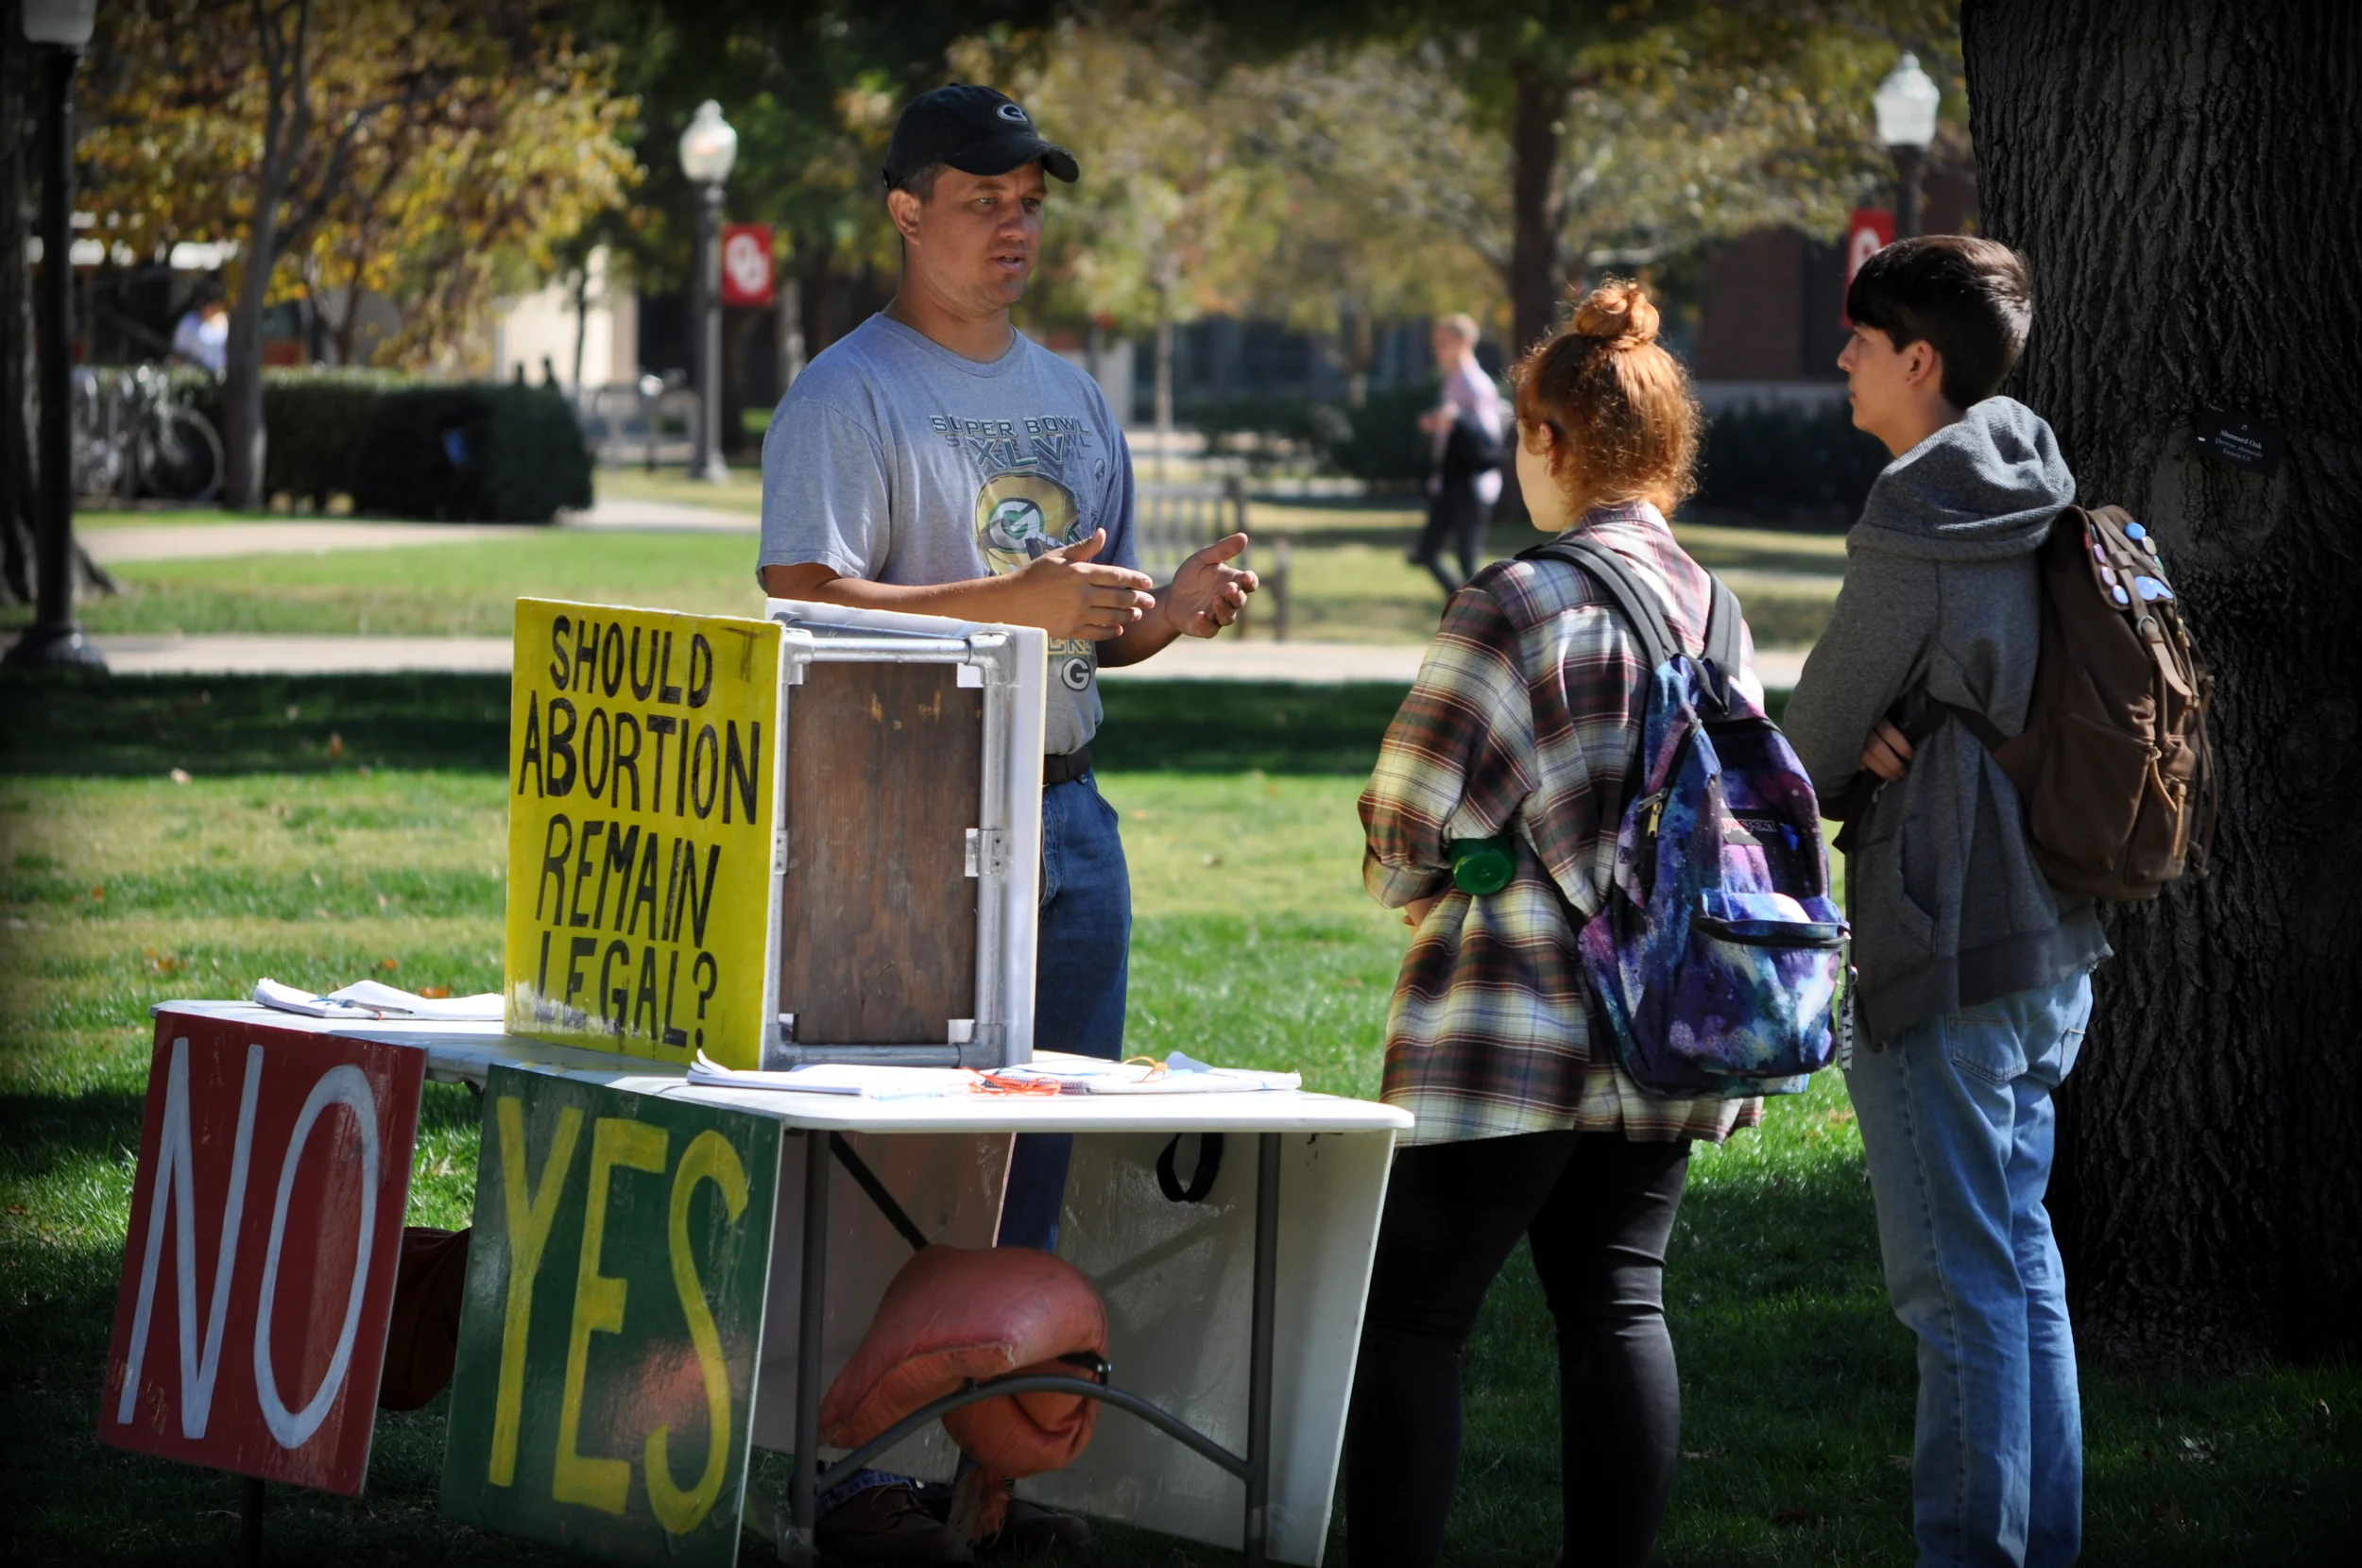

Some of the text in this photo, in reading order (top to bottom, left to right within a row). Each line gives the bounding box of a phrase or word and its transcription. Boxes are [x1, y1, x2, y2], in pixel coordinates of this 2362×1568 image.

[930, 414, 1091, 438] SUPER BOWL
[967, 434, 1065, 469] XLV
[549, 614, 713, 709] SHOULD
[1062, 657, 1090, 690] G
[518, 690, 760, 825] ABORTION
[536, 813, 721, 949] REMAIN
[535, 930, 718, 1049] LEGAL?
[117, 1037, 379, 1449] NO
[488, 1096, 748, 1535] YES
